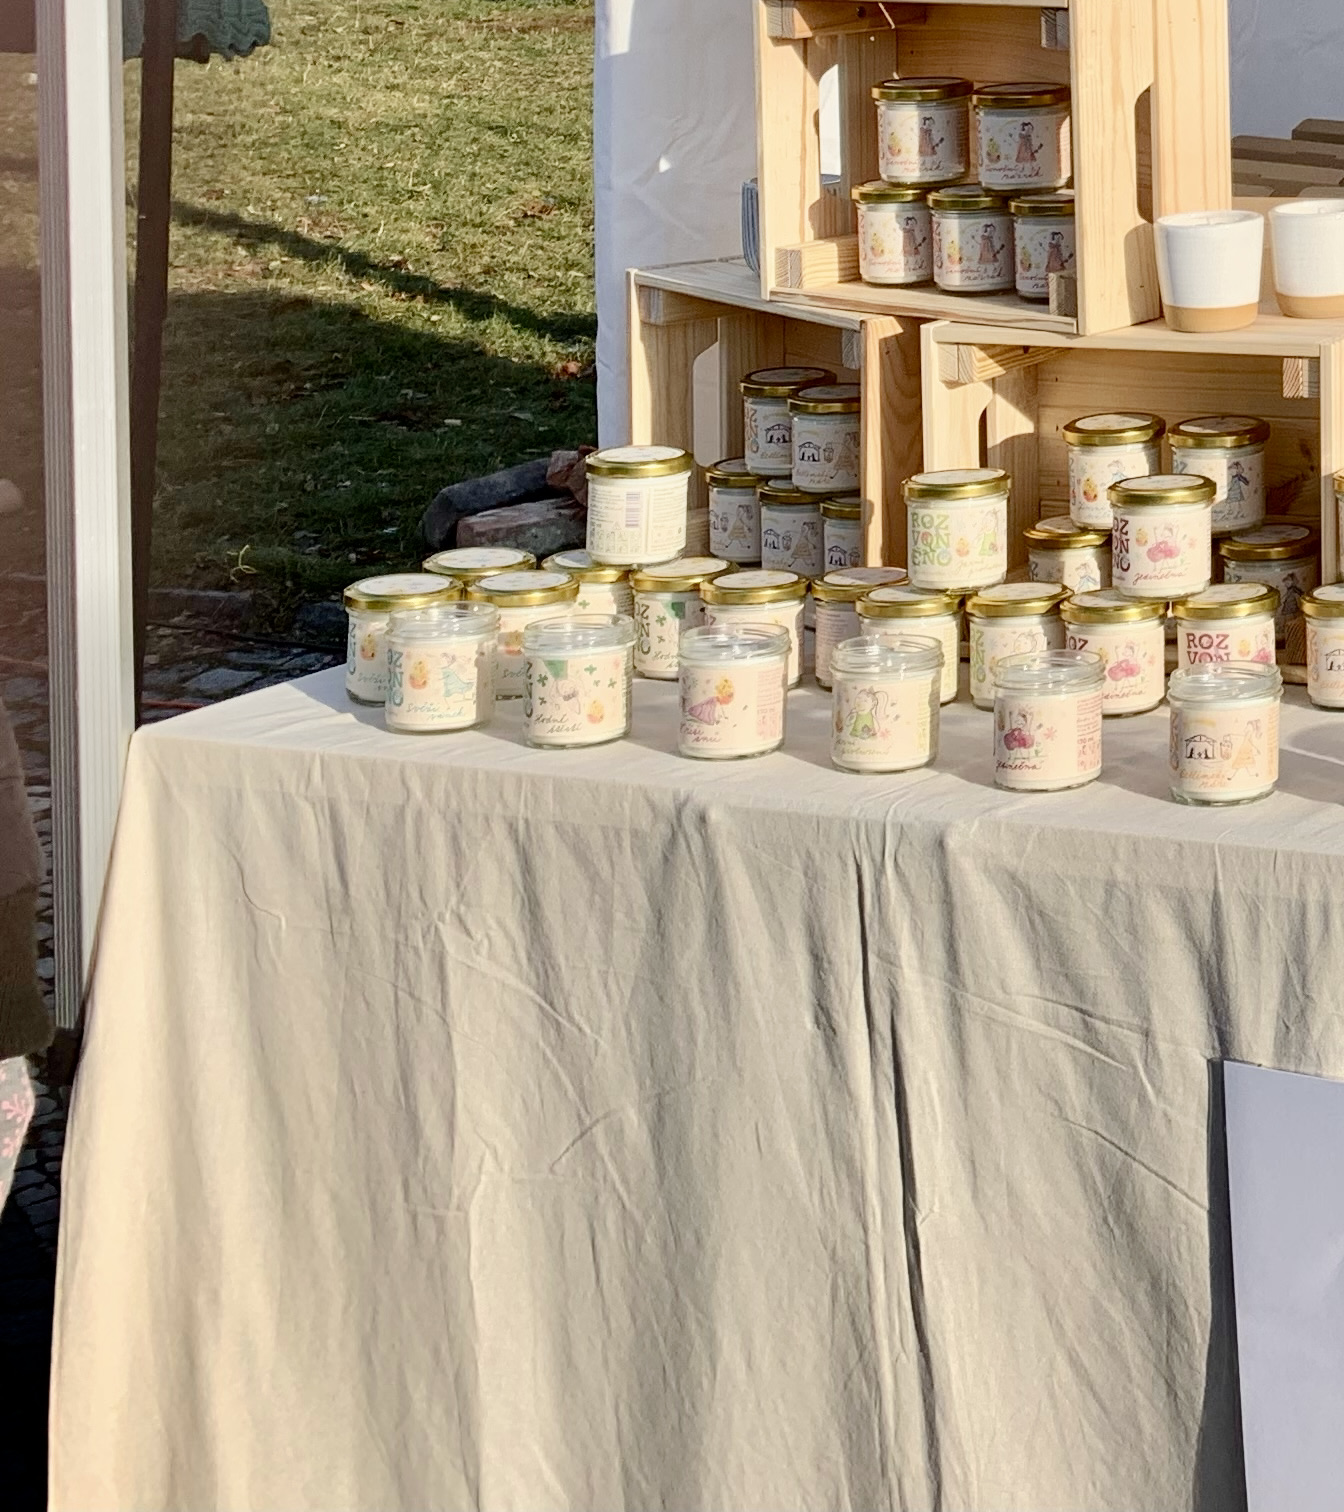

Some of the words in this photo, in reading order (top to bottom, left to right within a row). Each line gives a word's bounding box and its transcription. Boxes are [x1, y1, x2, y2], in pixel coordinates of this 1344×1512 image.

[911, 512, 950, 531] ROZ
[1113, 517, 1129, 536] OZ
[911, 530, 951, 552] VON
[1113, 536, 1130, 555] ON
[1186, 632, 1230, 649] ROZ
